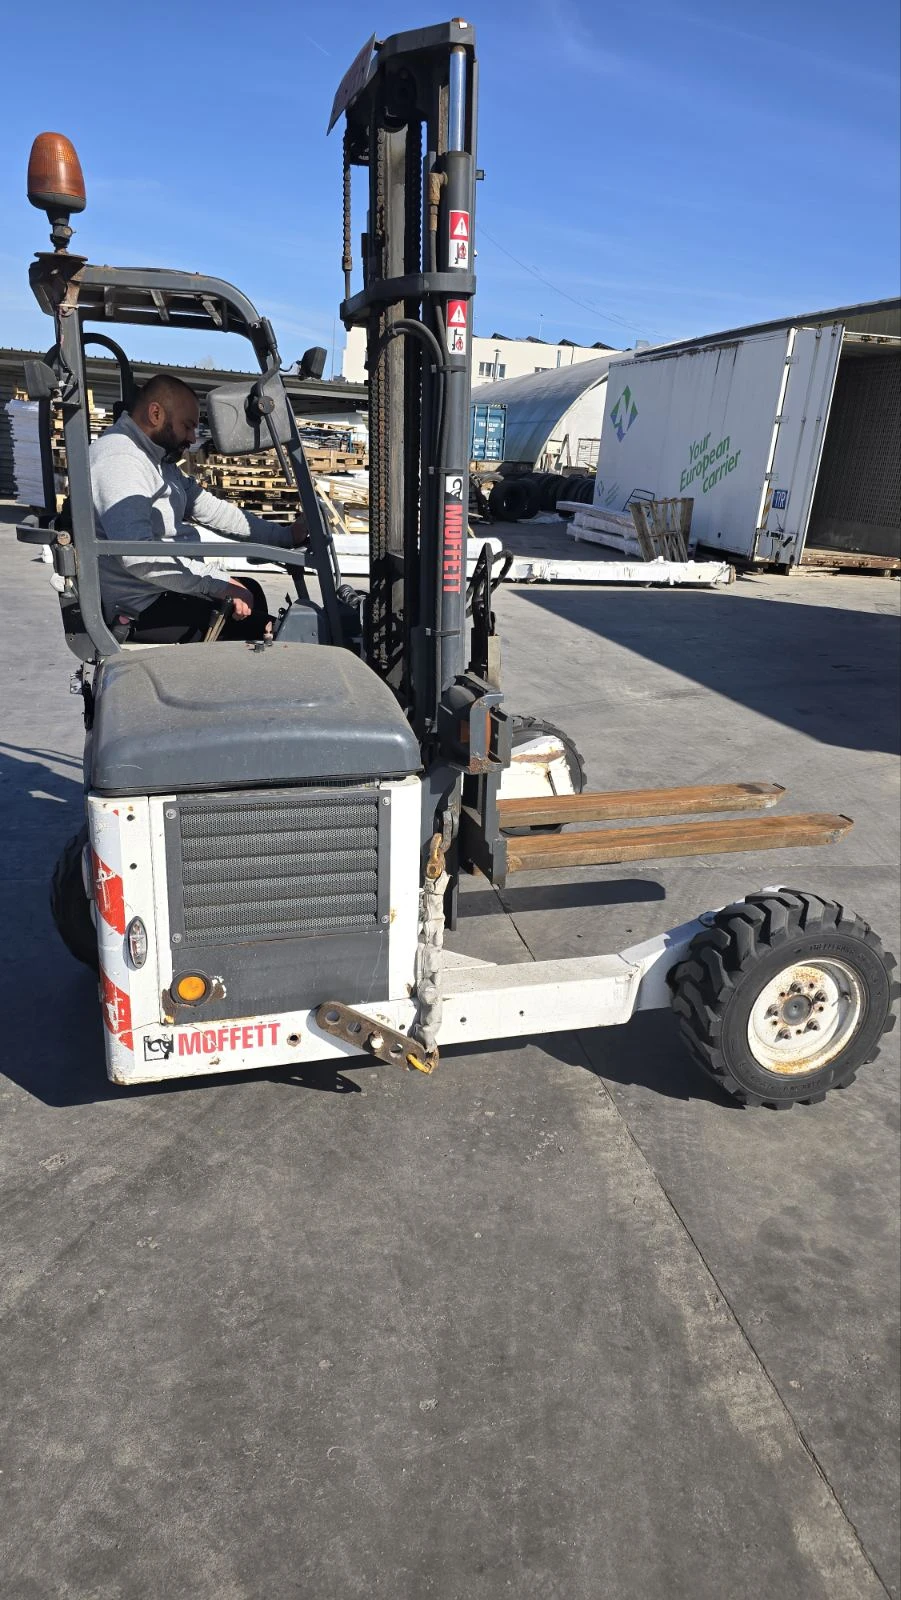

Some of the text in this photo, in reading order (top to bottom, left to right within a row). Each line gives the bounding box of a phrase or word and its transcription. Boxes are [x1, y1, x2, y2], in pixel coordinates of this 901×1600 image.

[679, 435, 730, 492] European
[689, 431, 711, 465] Your
[702, 449, 741, 493] carrier
[774, 491, 786, 508] TIR
[443, 504, 463, 593] MOFFETT
[178, 1023, 281, 1057] MOFFETT
